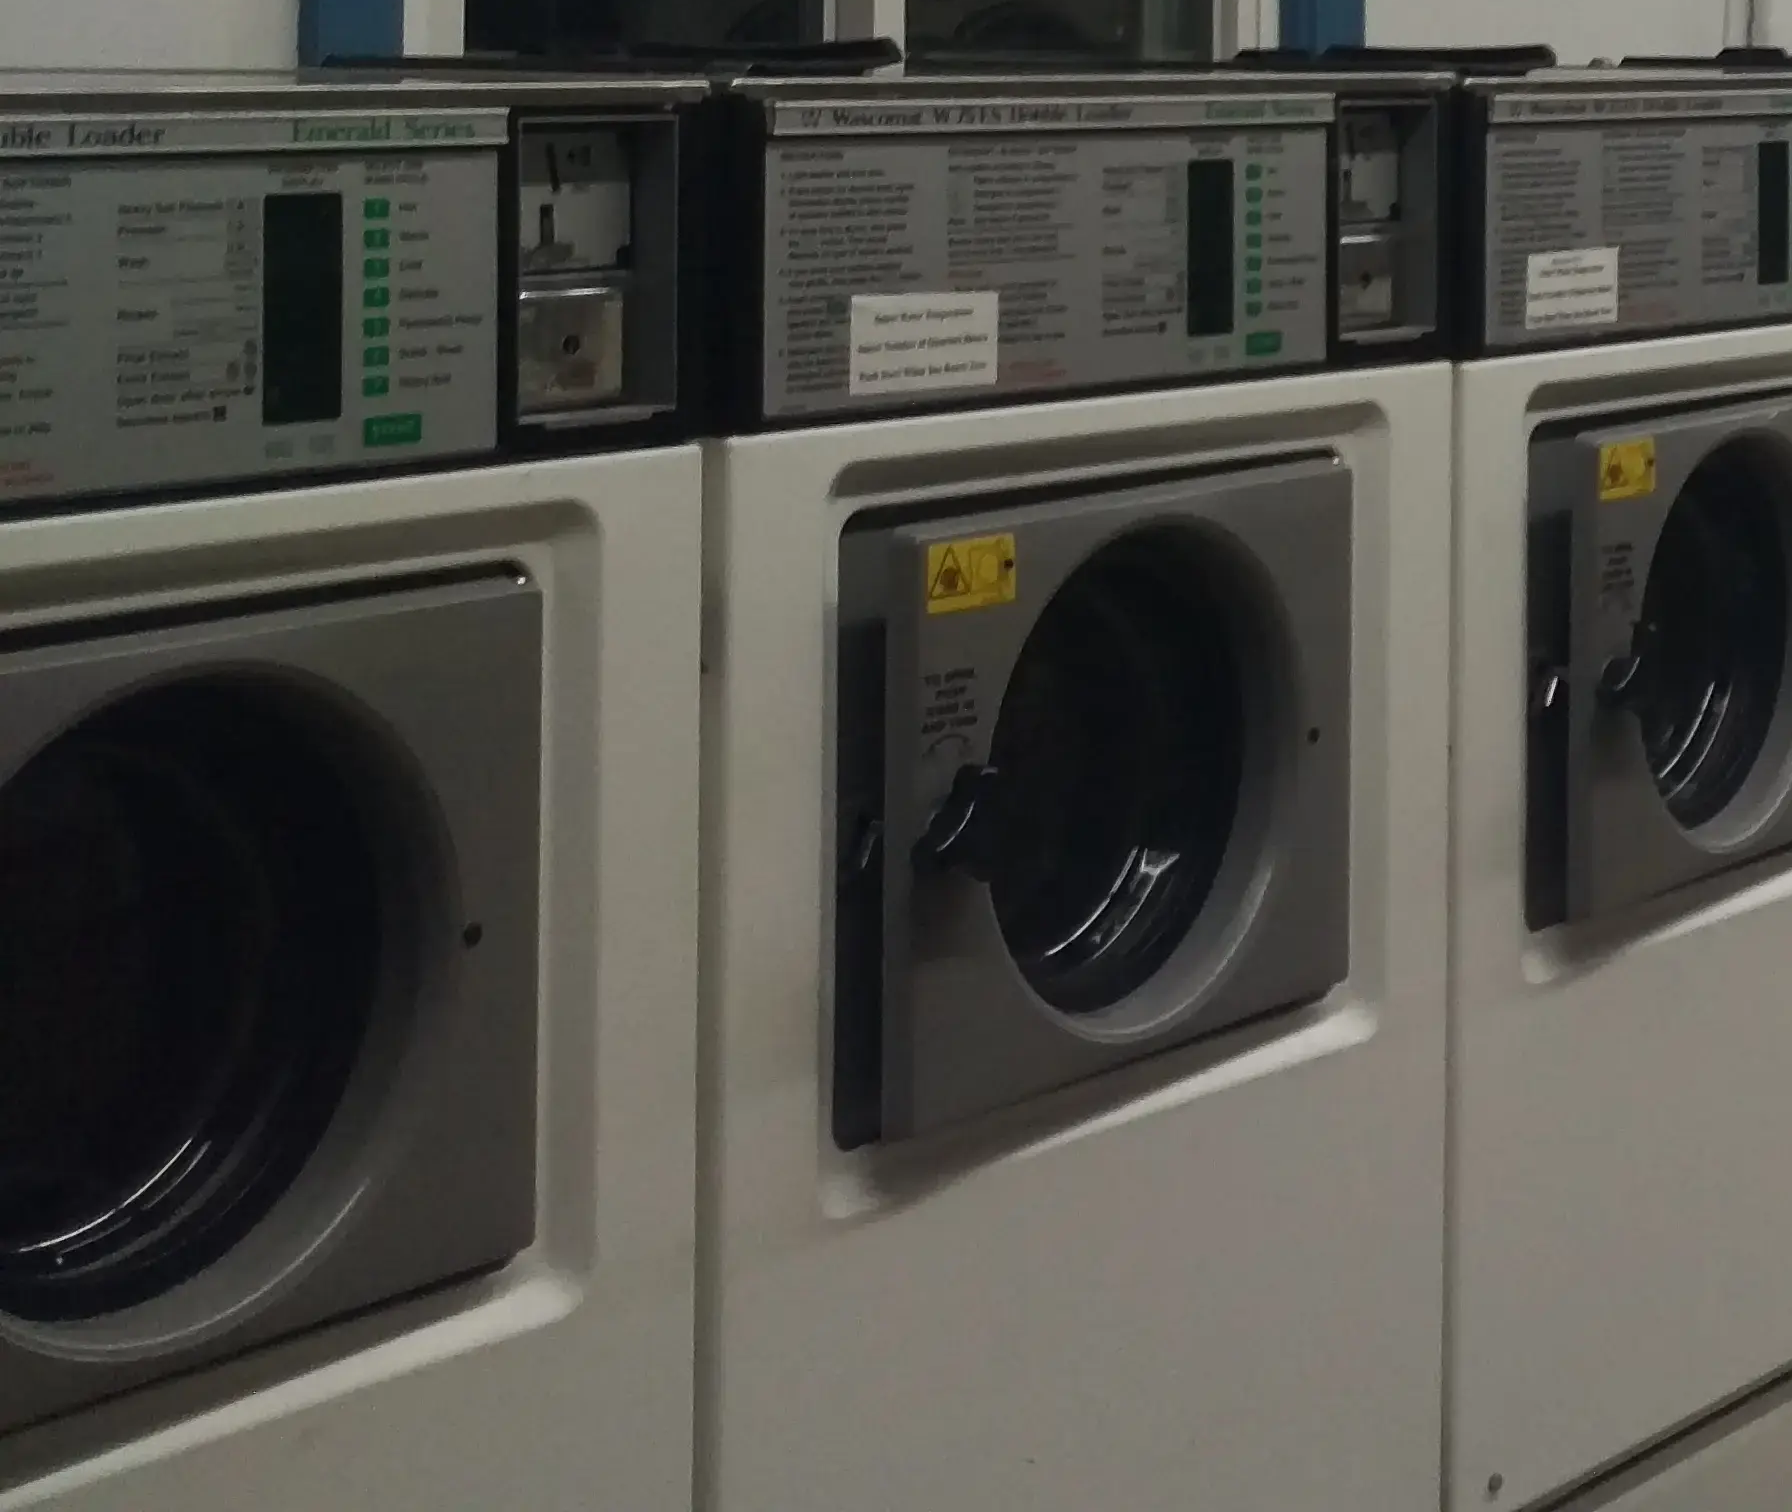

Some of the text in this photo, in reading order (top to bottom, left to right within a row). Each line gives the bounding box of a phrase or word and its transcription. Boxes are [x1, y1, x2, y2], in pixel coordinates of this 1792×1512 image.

[67, 123, 167, 147] Loader
[293, 117, 476, 142] Emerald Series
